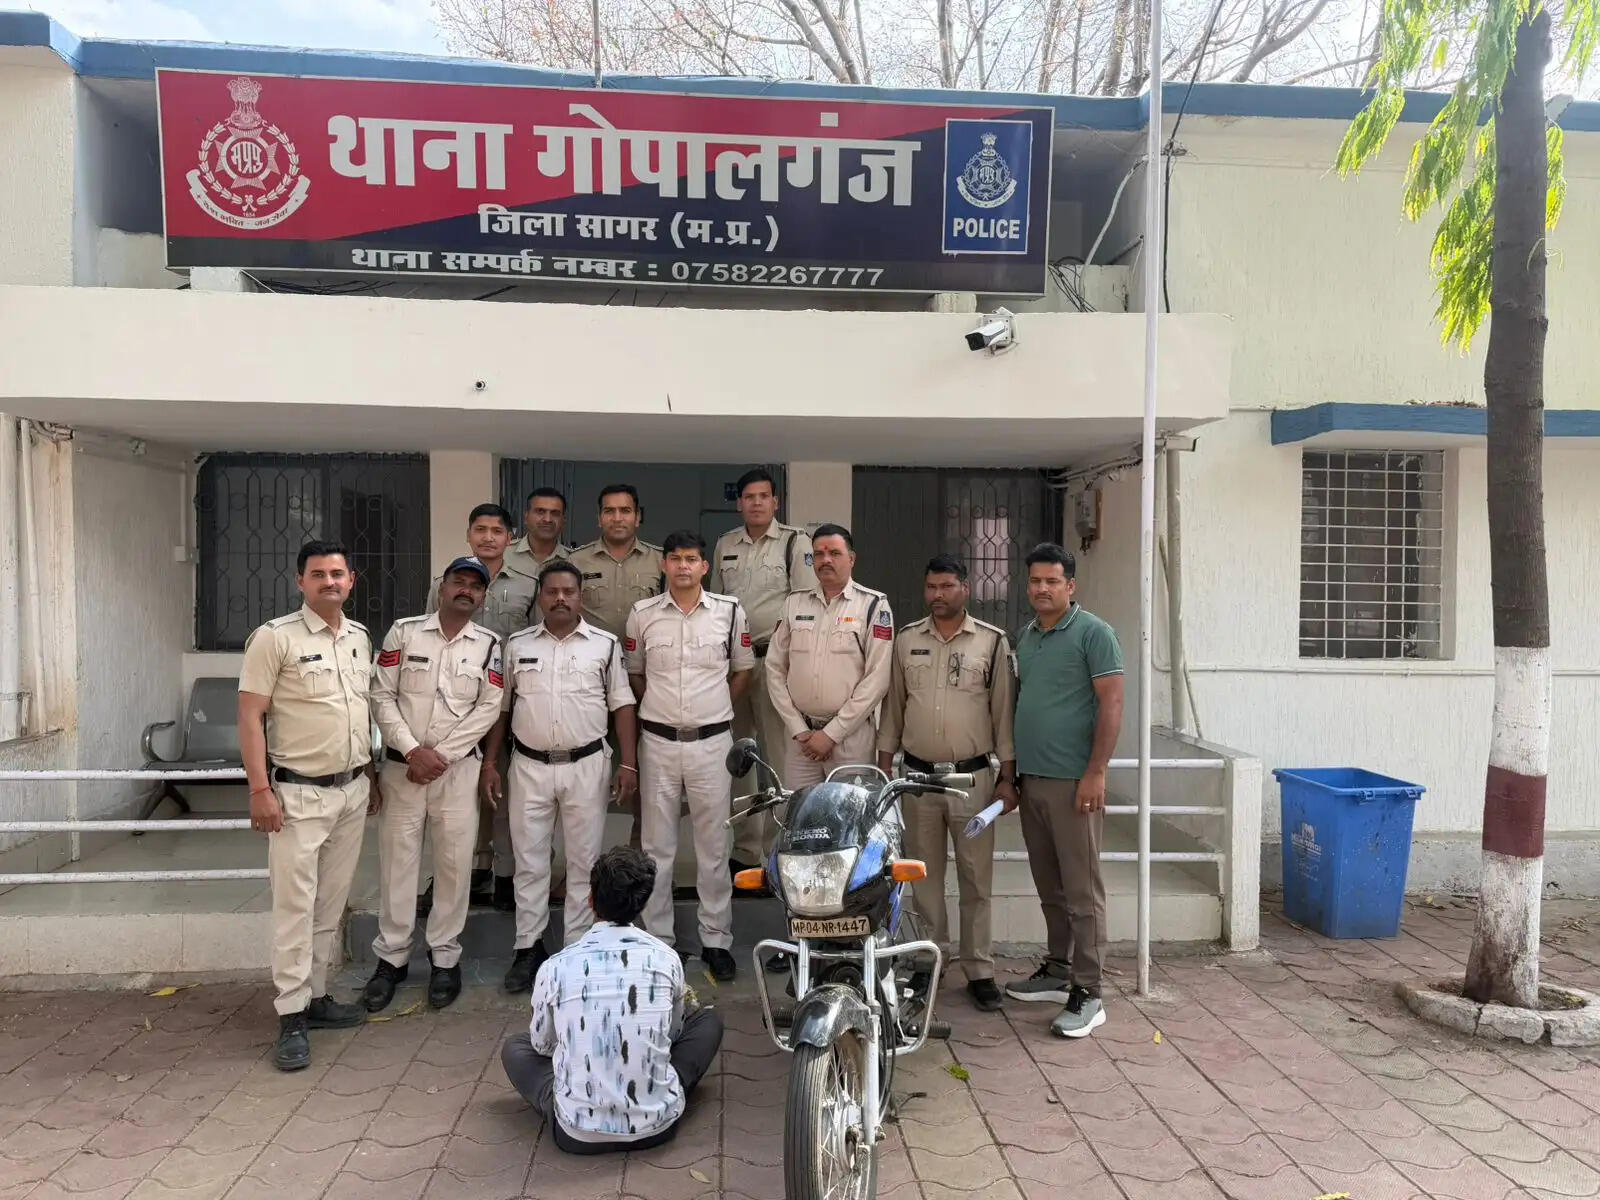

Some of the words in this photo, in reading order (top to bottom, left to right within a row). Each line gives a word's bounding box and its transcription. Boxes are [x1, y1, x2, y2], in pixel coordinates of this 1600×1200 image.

[328, 115, 513, 190] थाना
[533, 103, 921, 206] गोपालगंज
[478, 203, 567, 237] जिला
[575, 214, 659, 241] सागर
[952, 217, 1021, 239] POLICE
[352, 248, 433, 270] थाना
[441, 249, 544, 273] सम्पर्क
[552, 257, 637, 278] नम्बर
[671, 262, 884, 286] 07582267777
